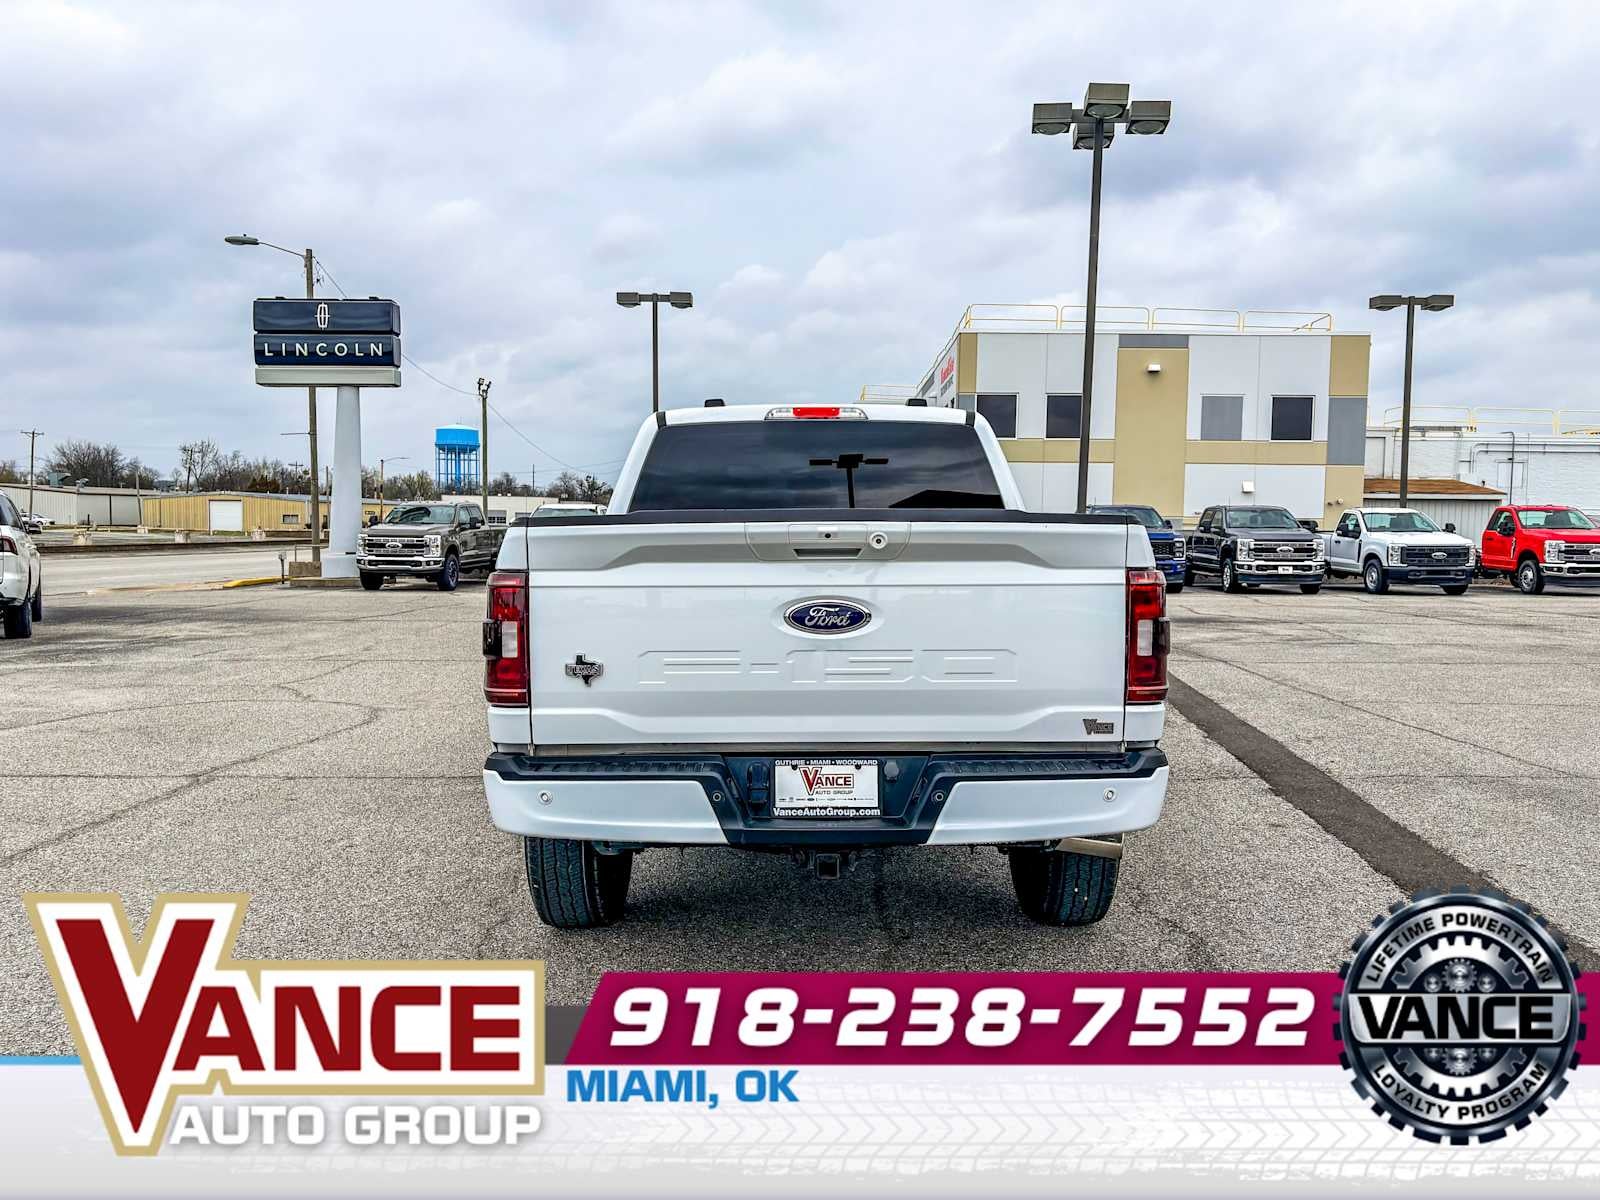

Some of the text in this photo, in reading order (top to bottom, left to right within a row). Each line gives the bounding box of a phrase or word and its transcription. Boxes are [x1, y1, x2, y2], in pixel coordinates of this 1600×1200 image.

[264, 343, 383, 356] LINCOLN
[804, 605, 850, 628] Ford
[638, 649, 1018, 684] F-150
[801, 768, 852, 794] VANCE
[773, 807, 880, 817] VanceAutoGroup.com
